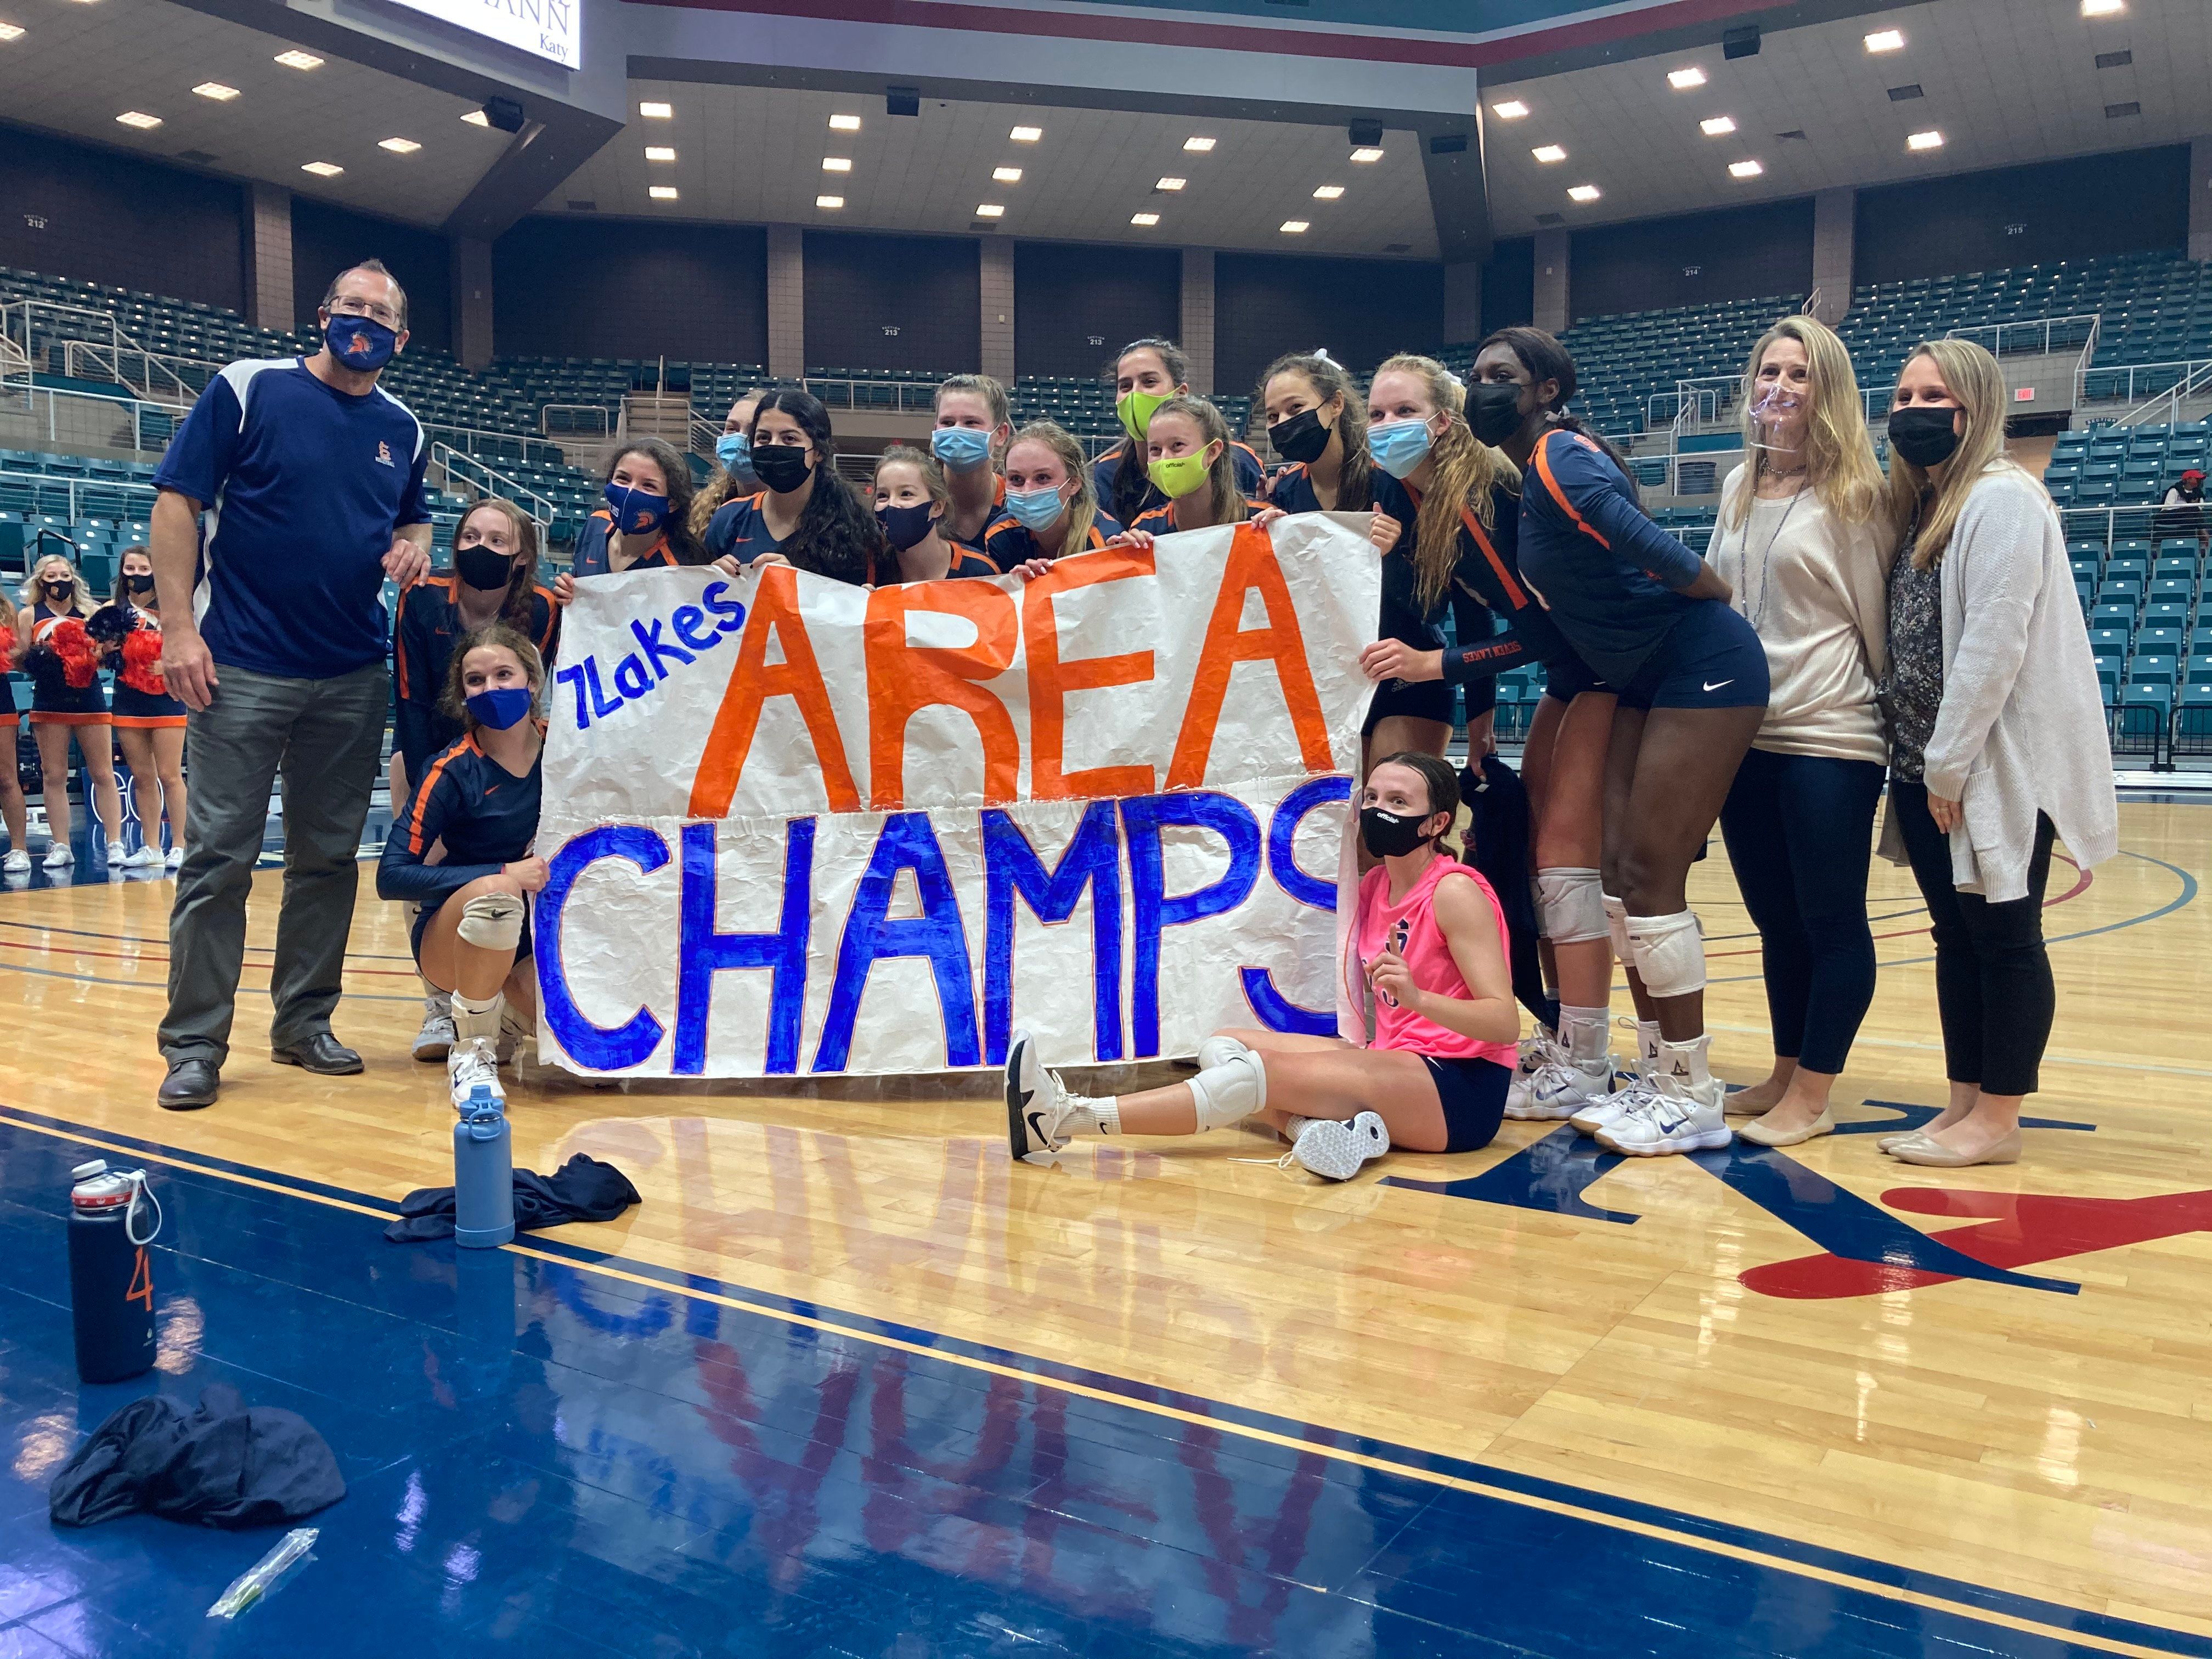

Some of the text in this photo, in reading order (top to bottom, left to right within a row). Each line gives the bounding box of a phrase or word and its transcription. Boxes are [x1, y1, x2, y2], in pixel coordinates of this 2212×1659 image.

[540, 33, 568, 62] Katy
[28, 219, 44, 229] 212
[687, 523, 1336, 818] AREA
[534, 775, 1355, 1075] CHAMPS
[126, 1246, 154, 1312] 4
